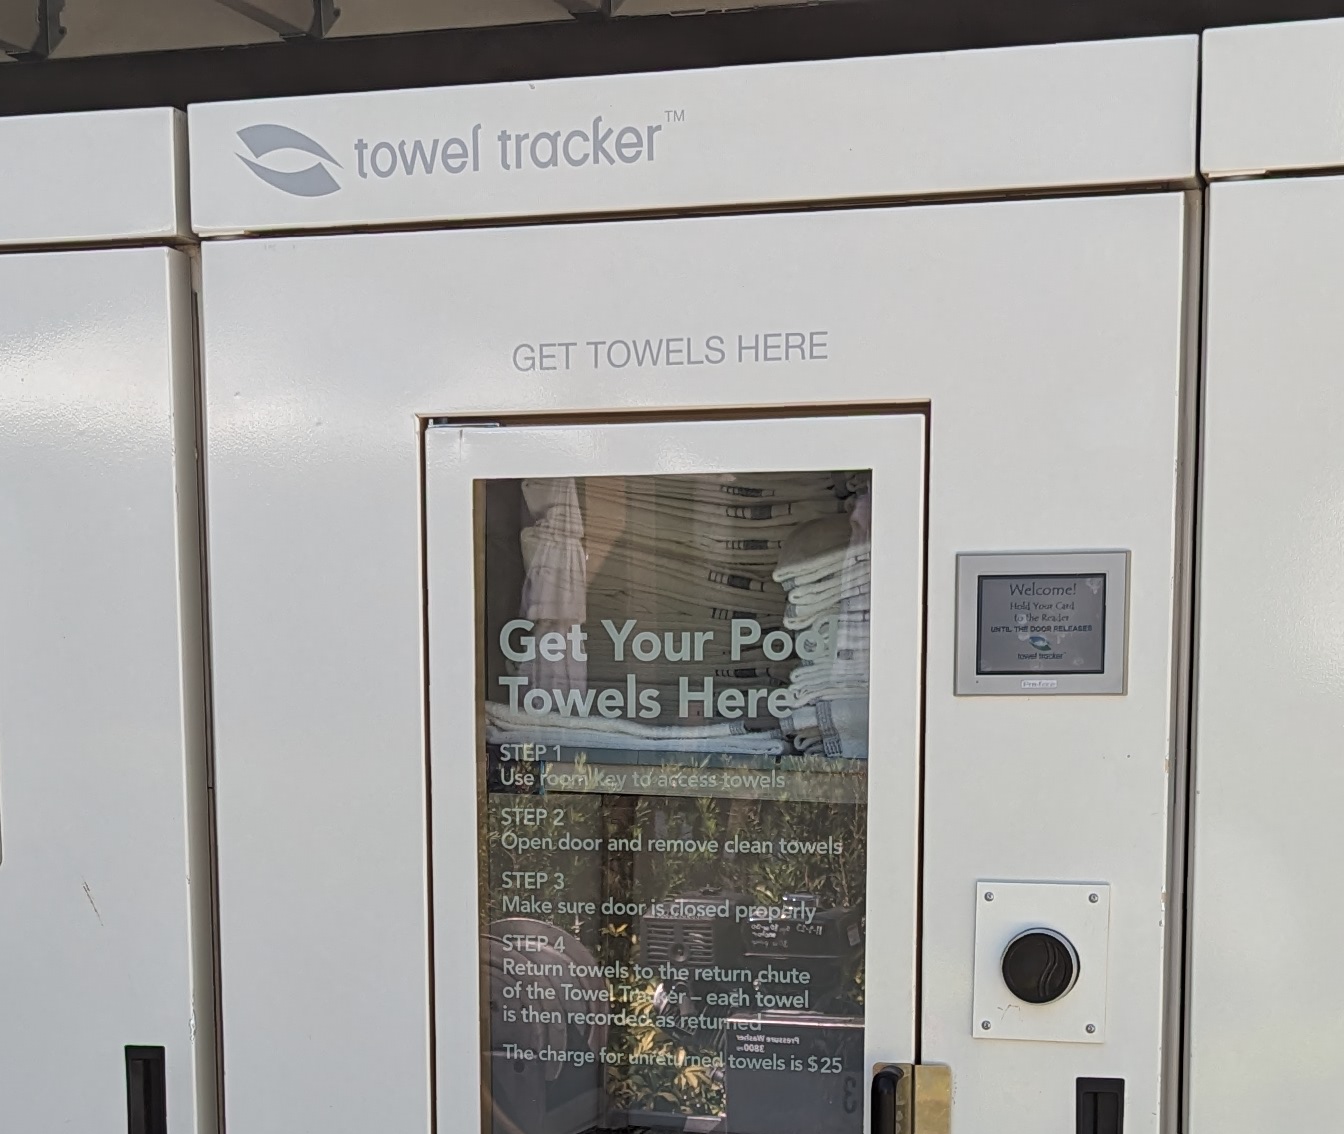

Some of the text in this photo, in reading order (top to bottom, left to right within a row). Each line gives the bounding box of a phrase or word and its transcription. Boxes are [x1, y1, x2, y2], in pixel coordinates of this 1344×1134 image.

[354, 123, 481, 180] towel
[512, 331, 829, 372] GET TOWELS HERE
[1009, 582, 1077, 596] Welcome!
[499, 615, 838, 662] Get Your Pool
[498, 673, 794, 719] Towels Here
[499, 744, 561, 762] STEP 1
[500, 769, 785, 791] Use room key to access towels
[500, 808, 564, 826] STEP 2
[500, 832, 843, 855] Open door and remove clean towels
[501, 871, 565, 889] STEP 3
[502, 896, 816, 924] Make sure door is closed properly
[502, 935, 566, 952] STEP 4
[503, 959, 811, 985] Return towels to the return chute
[503, 982, 522, 999] of
[526, 982, 556, 1000] the
[560, 984, 614, 1002] Towel
[618, 985, 686, 1004] Traer
[706, 987, 750, 1007] each
[755, 990, 809, 1009] towel
[503, 1005, 762, 1032] is then recorded as returned
[503, 1043, 534, 1060] The
[538, 1045, 595, 1068] charge
[599, 1047, 624, 1064] for
[628, 1049, 725, 1068] unreturned
[728, 1051, 786, 1071] towels
[790, 1053, 803, 1071] is
